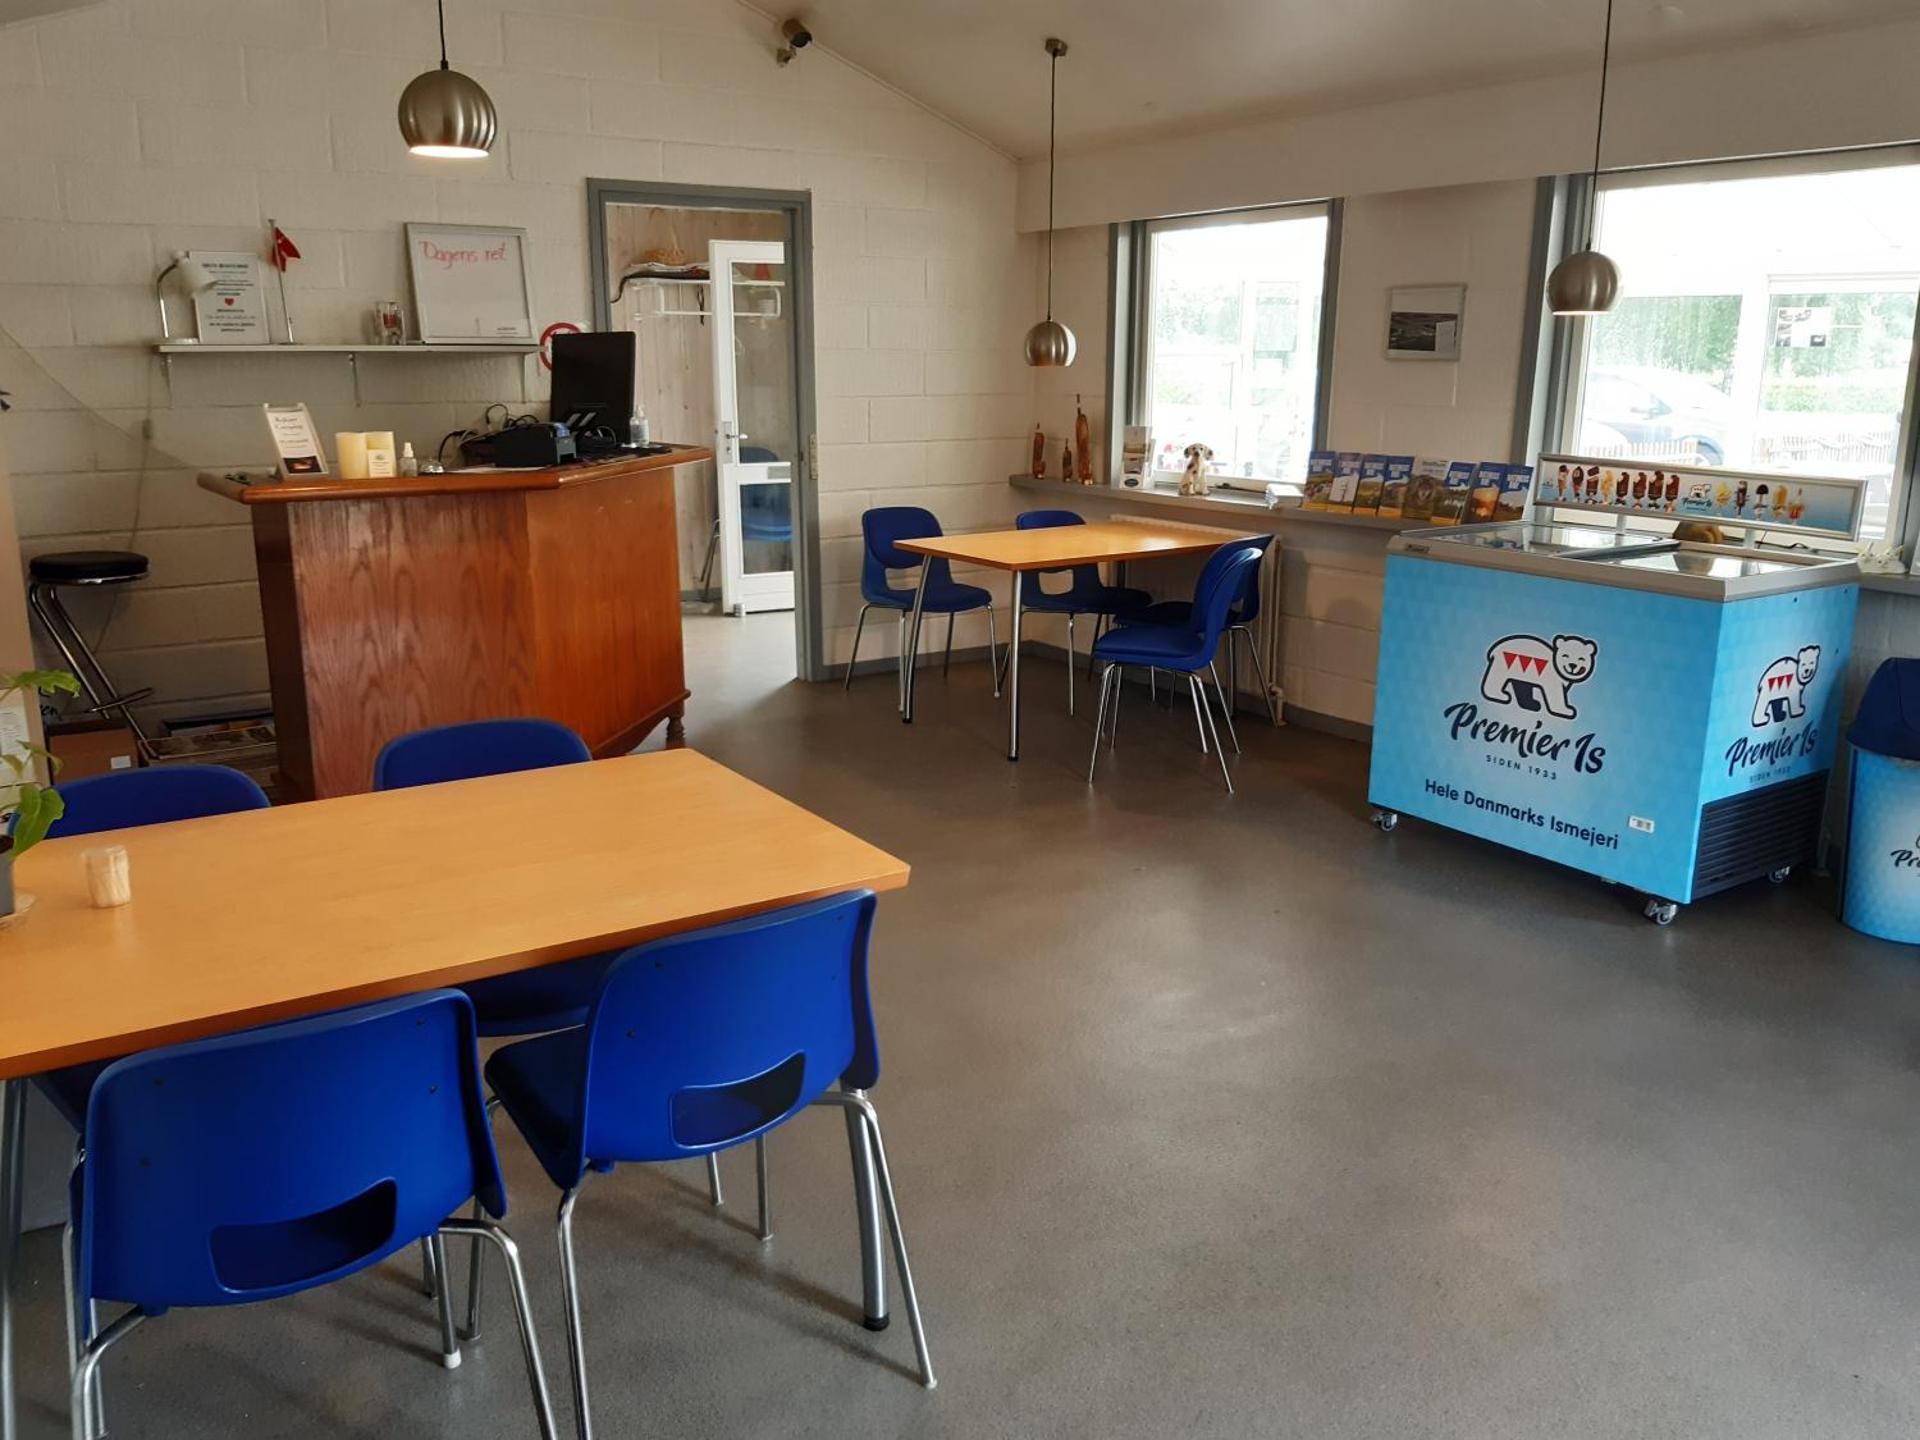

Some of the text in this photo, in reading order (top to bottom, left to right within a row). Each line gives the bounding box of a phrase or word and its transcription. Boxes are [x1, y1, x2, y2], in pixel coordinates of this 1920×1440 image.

[418, 240, 507, 270] Dagens ret
[1443, 702, 1606, 774] Premier Is
[1485, 754, 1521, 771] SIDEN
[1725, 720, 1818, 777] Premier Is
[1425, 778, 1619, 850] Hele Danmarks Ismejeri
